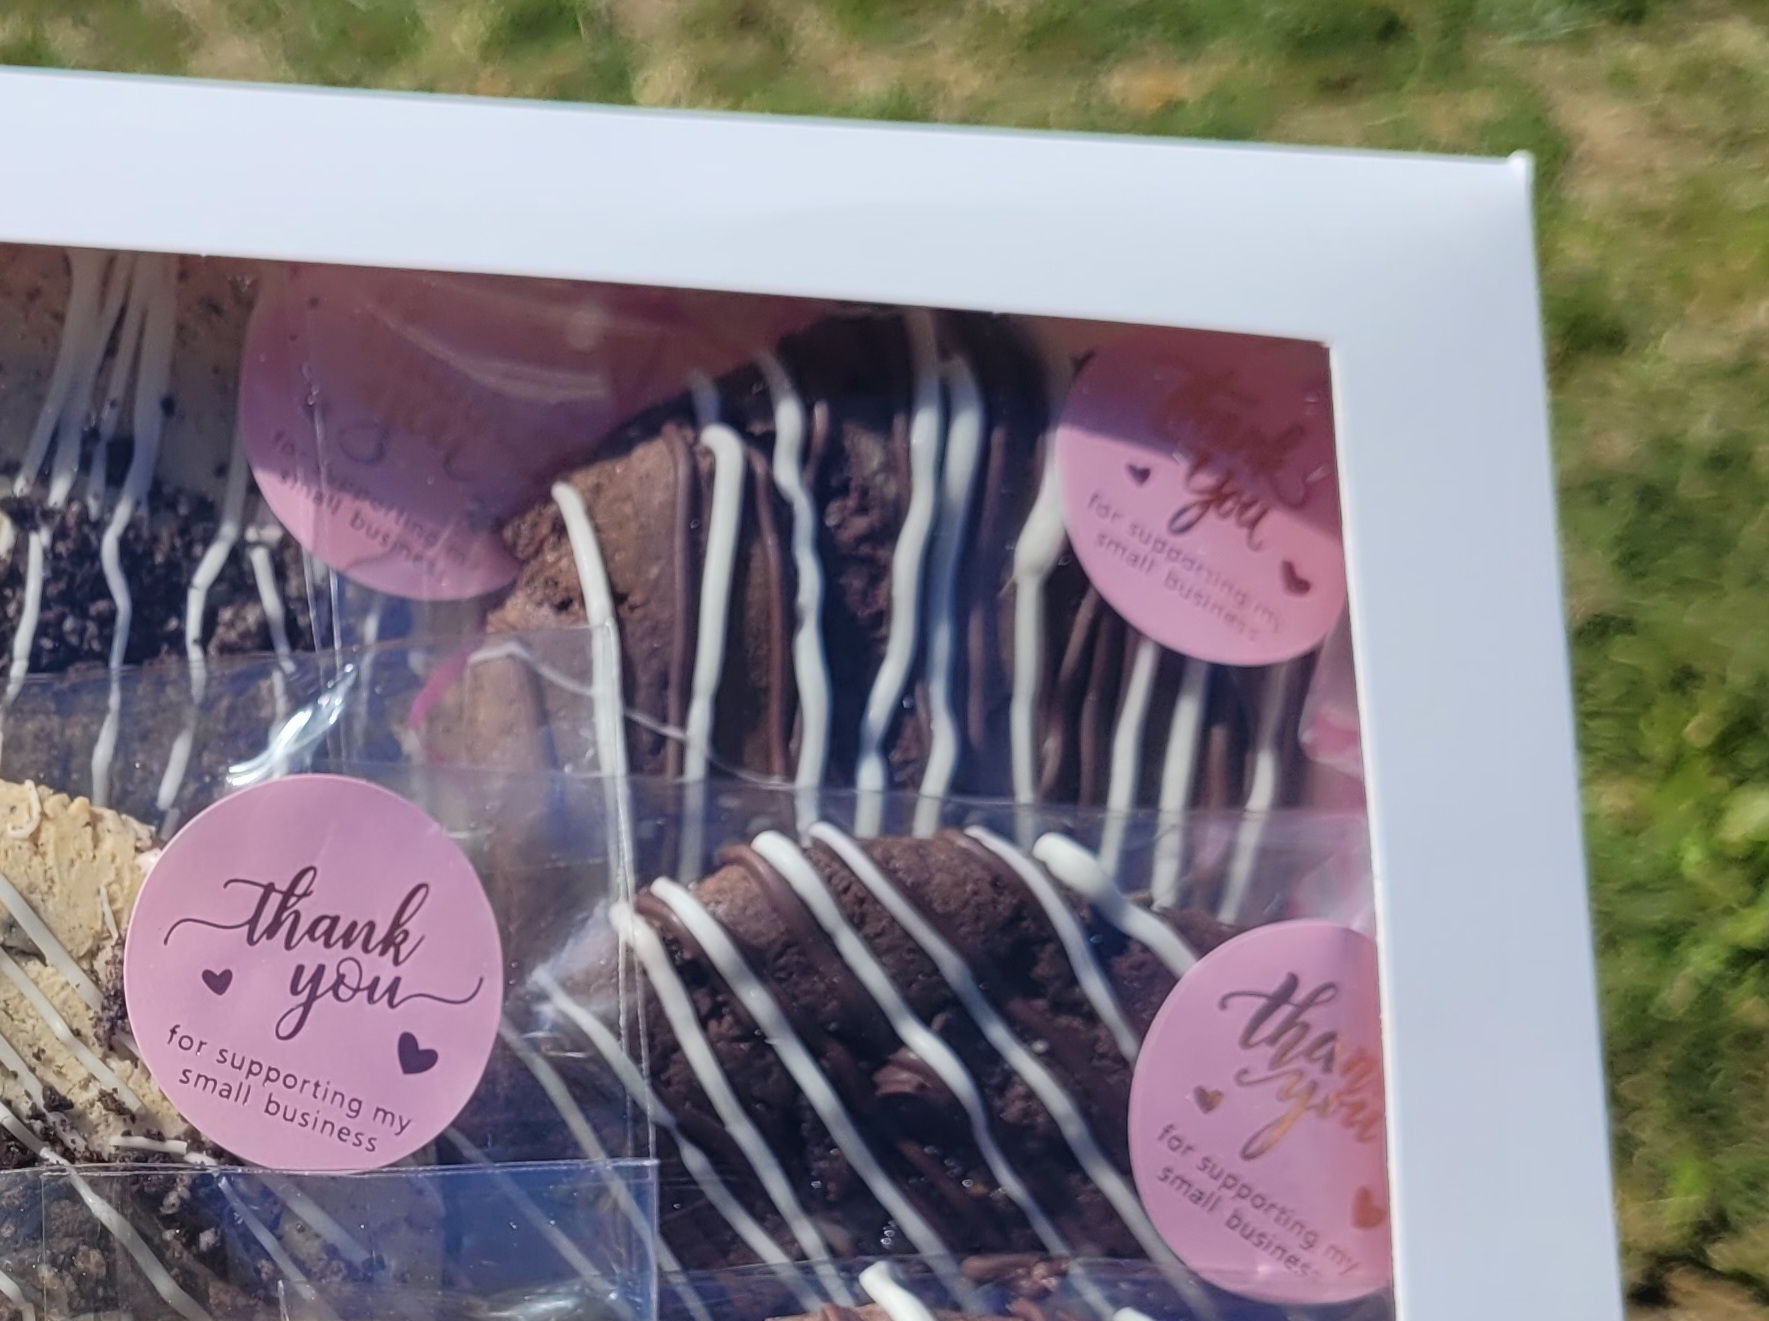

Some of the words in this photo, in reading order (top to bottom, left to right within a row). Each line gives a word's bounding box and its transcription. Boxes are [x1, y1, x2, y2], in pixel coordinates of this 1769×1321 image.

[1096, 532, 1156, 574] small
[164, 865, 429, 966] thank
[275, 957, 484, 1041] you
[168, 1024, 207, 1055] for
[217, 1046, 363, 1119] supporting
[373, 1105, 412, 1136] my
[178, 1066, 251, 1107] small
[264, 1093, 377, 1153] business
[1157, 1124, 1194, 1157] for
[1200, 1155, 1319, 1249] supporting
[1323, 1243, 1361, 1277] my
[1158, 1165, 1220, 1215] small
